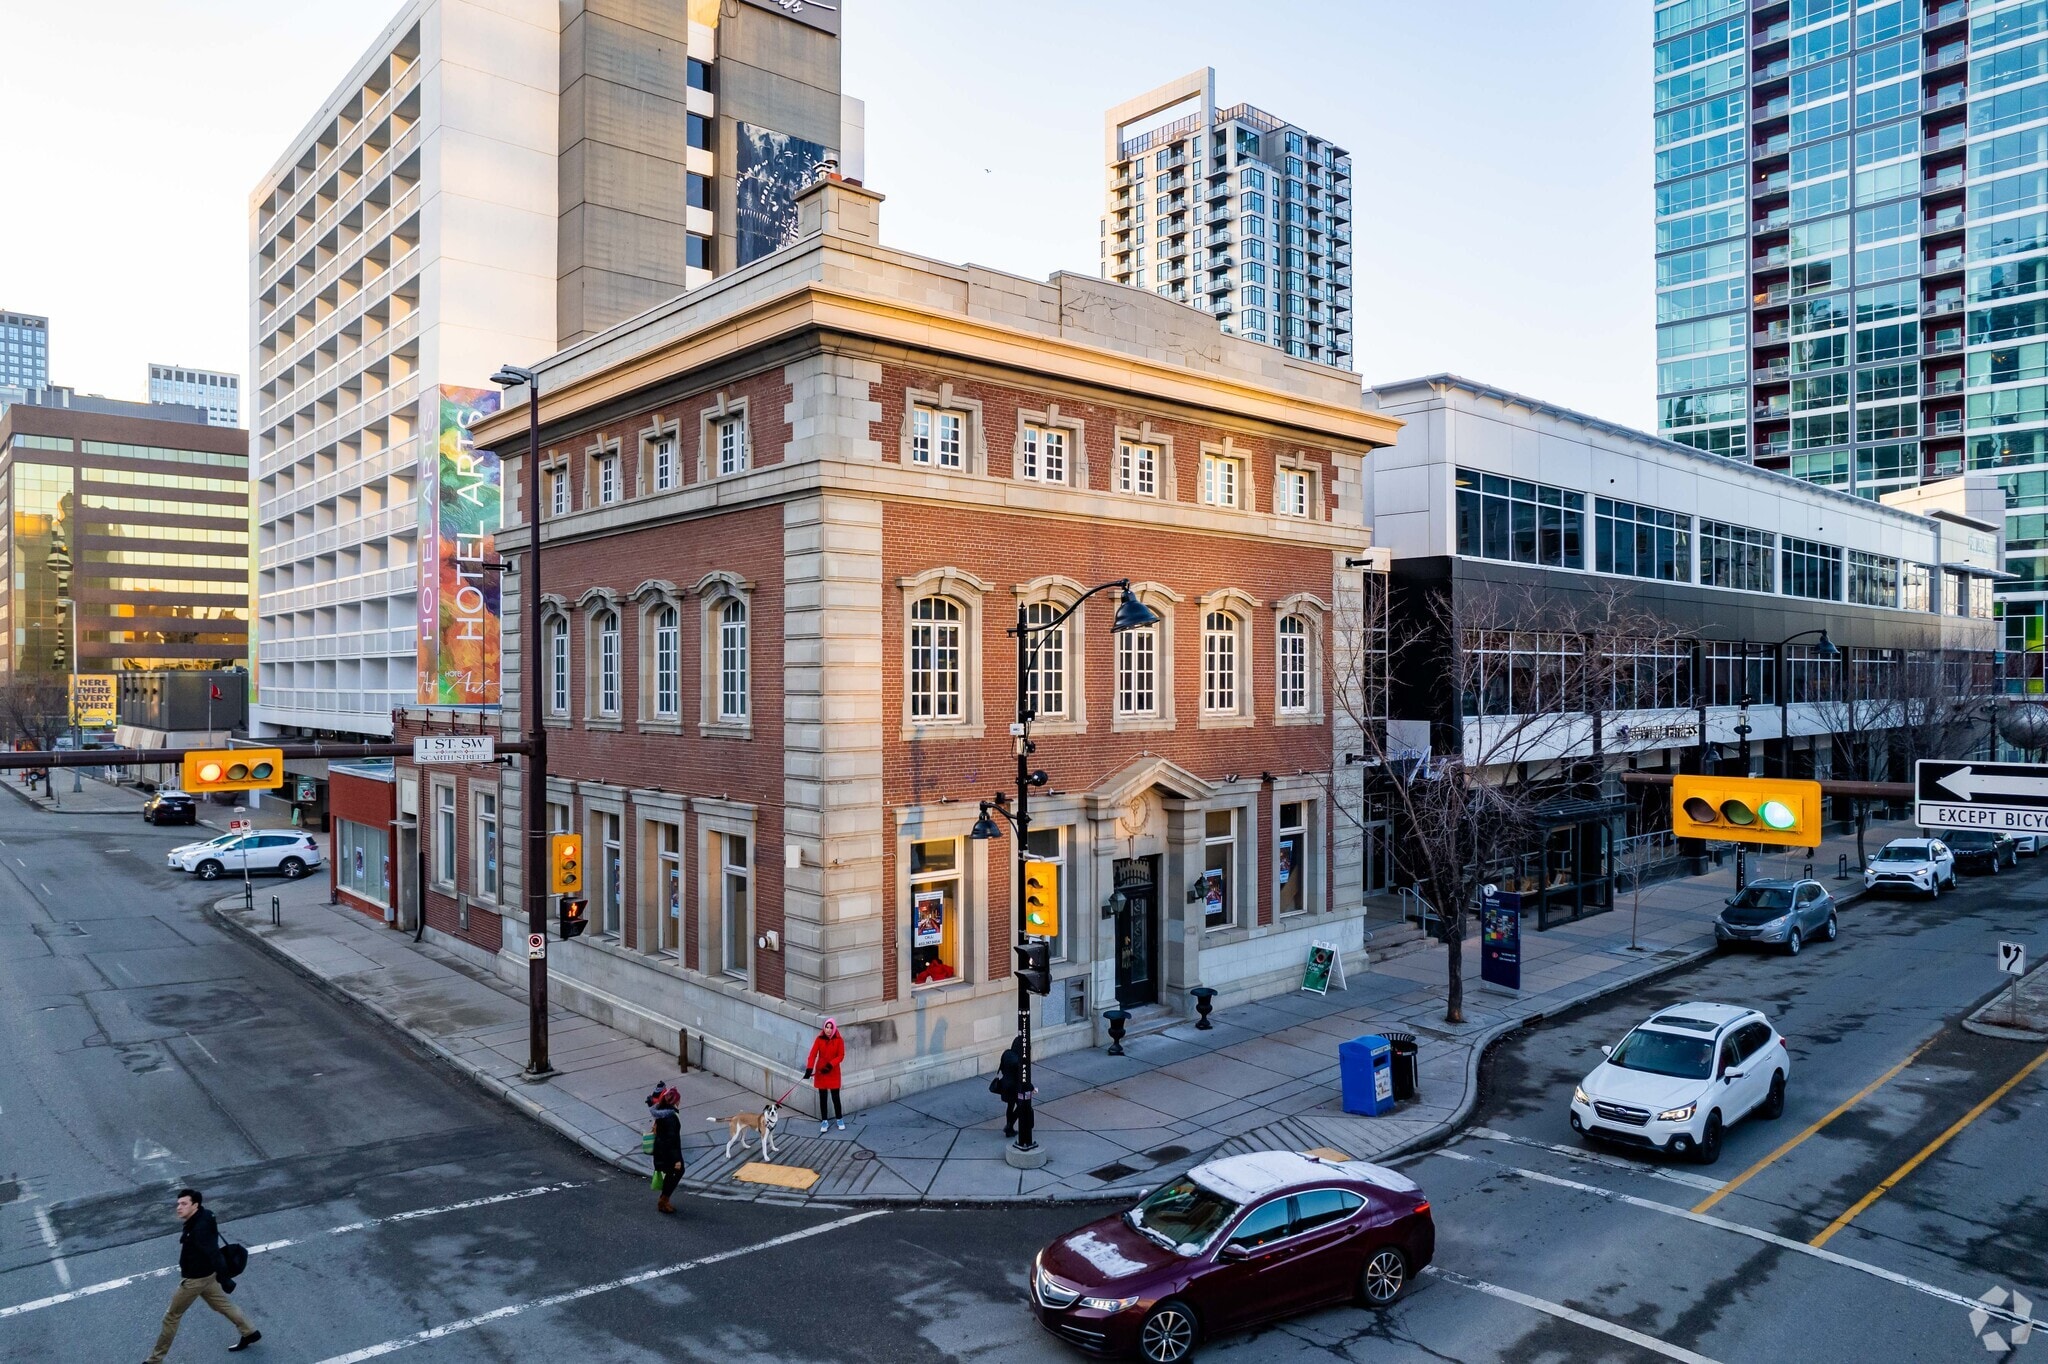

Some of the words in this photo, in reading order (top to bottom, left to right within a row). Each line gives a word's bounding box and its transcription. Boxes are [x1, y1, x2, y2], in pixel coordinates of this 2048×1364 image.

[422, 410, 434, 505] ARTS
[456, 410, 484, 507] ARTS
[422, 519, 433, 641] HOTEL
[456, 520, 484, 640] HOTEL
[461, 738, 485, 749] SW
[1939, 808, 1996, 825] EXCEPT
[2005, 812, 2048, 828] BICY
